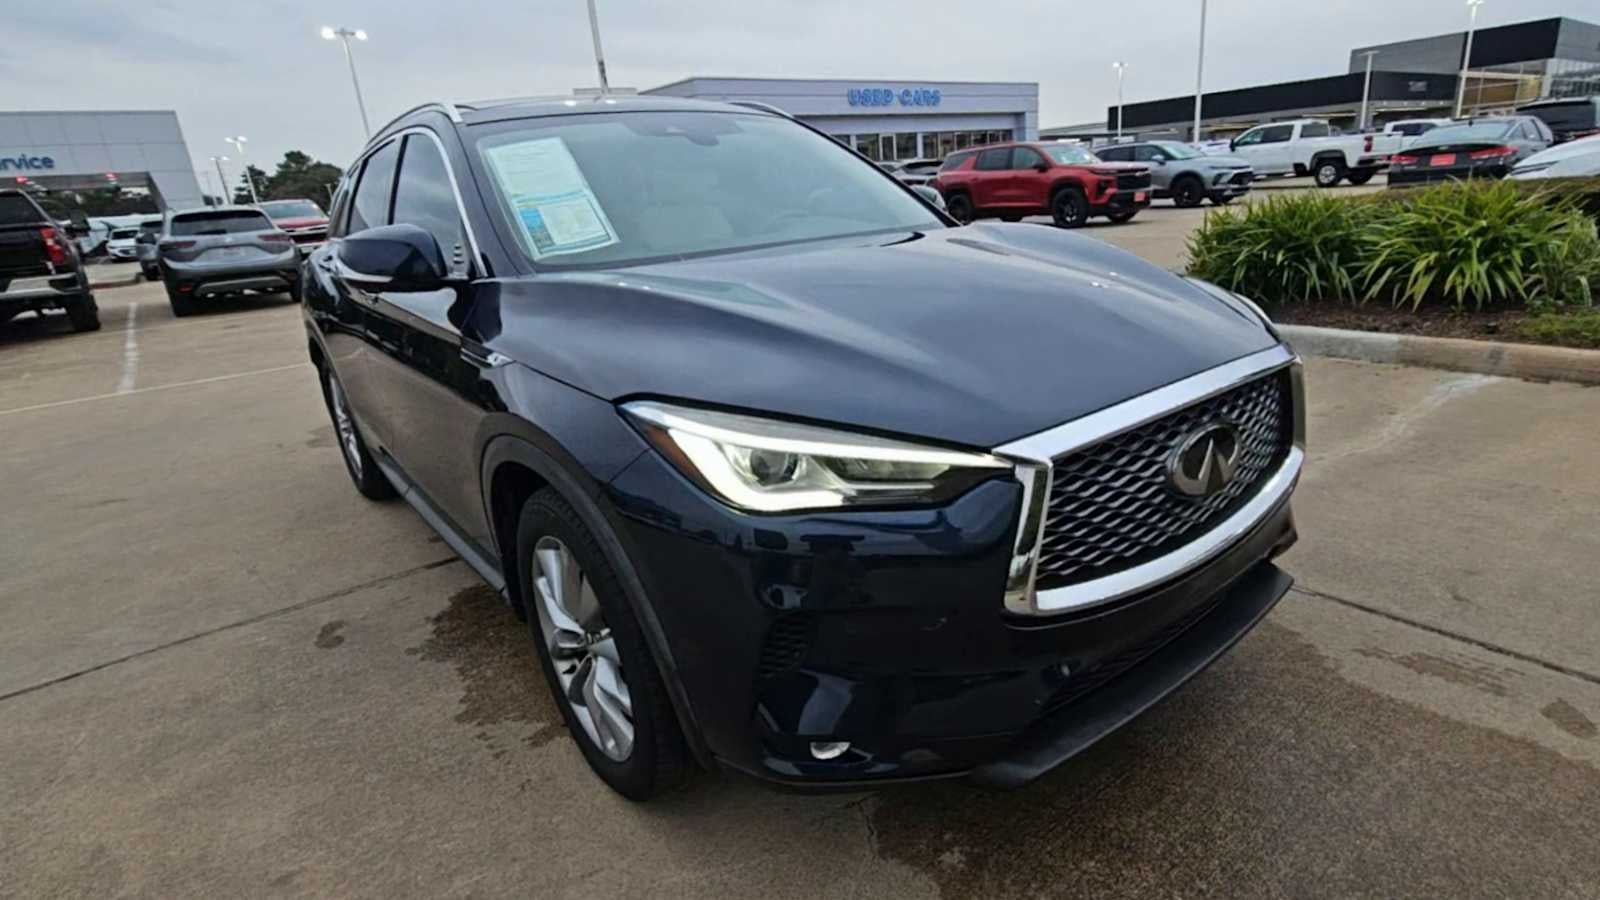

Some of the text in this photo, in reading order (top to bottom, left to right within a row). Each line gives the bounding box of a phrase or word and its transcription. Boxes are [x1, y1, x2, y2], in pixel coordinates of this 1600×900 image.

[848, 88, 941, 107] USED CARS
[0, 153, 54, 171] rvice
